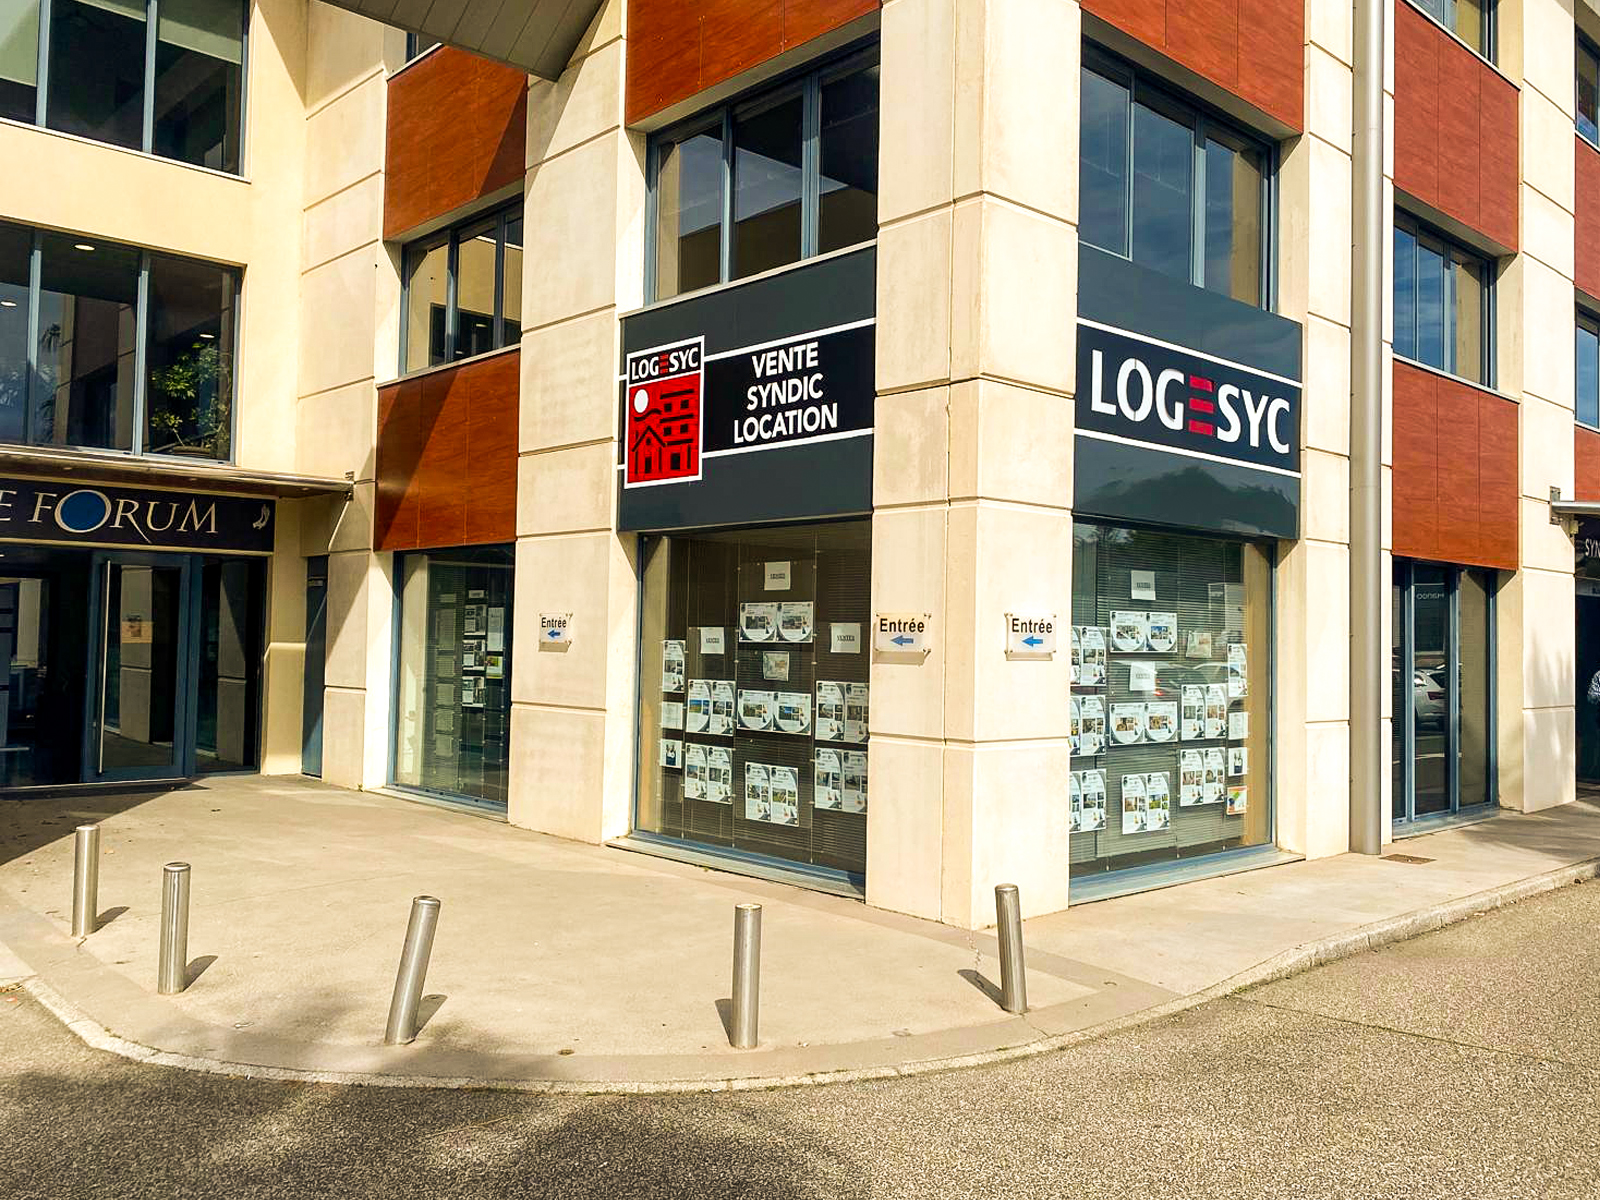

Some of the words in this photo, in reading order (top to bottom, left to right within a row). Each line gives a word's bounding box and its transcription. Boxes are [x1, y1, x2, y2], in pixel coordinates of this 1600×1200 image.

[631, 347, 699, 380] LOGESYC
[752, 342, 819, 378] VENTE
[746, 374, 823, 410] SYNDIC
[1091, 350, 1290, 454] LOGESYC
[733, 403, 838, 444] LOCATION
[27, 490, 218, 544] FORUM
[541, 616, 567, 628] Entrée
[880, 617, 925, 633] Entrée
[1011, 618, 1053, 634] Entrée
